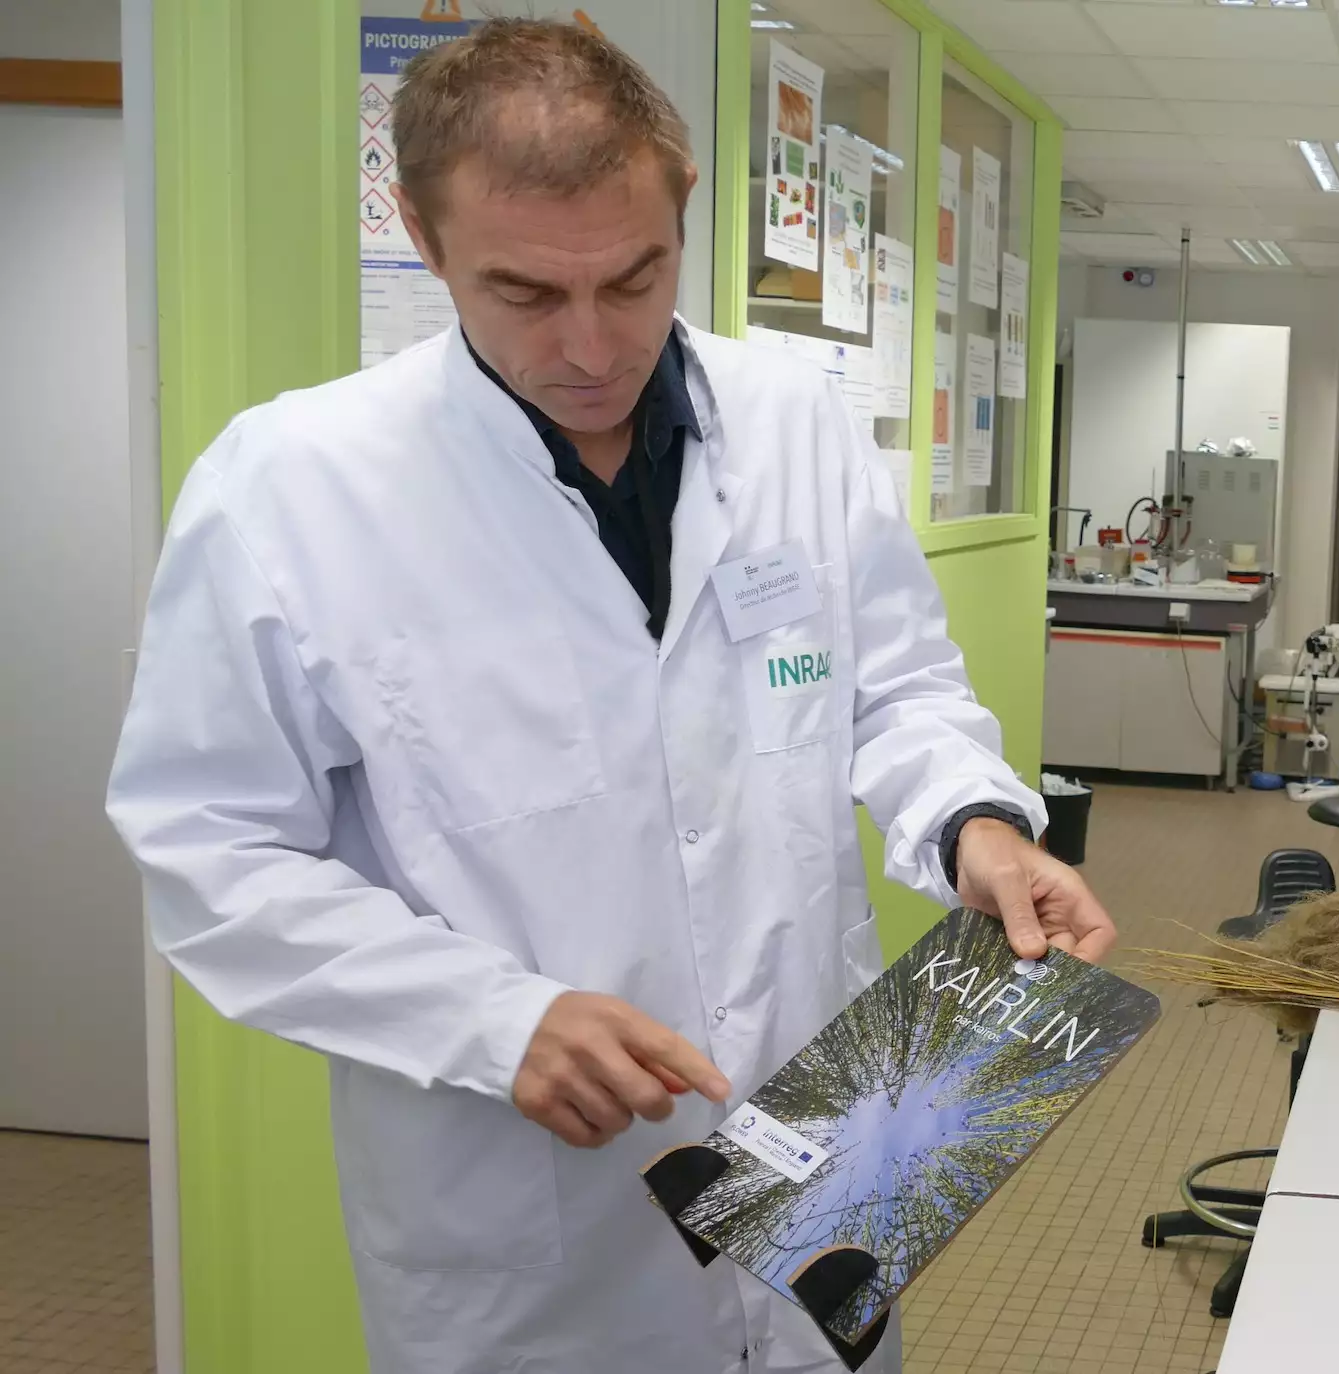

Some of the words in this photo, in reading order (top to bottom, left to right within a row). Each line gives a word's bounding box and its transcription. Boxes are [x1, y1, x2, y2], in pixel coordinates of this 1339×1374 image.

[734, 587, 759, 601] Johnny
[759, 571, 800, 593] BEAUGRAND
[912, 949, 1101, 1062] KAIRLIN
[952, 1013, 973, 1031] par
[762, 1128, 801, 1157] Interreg
